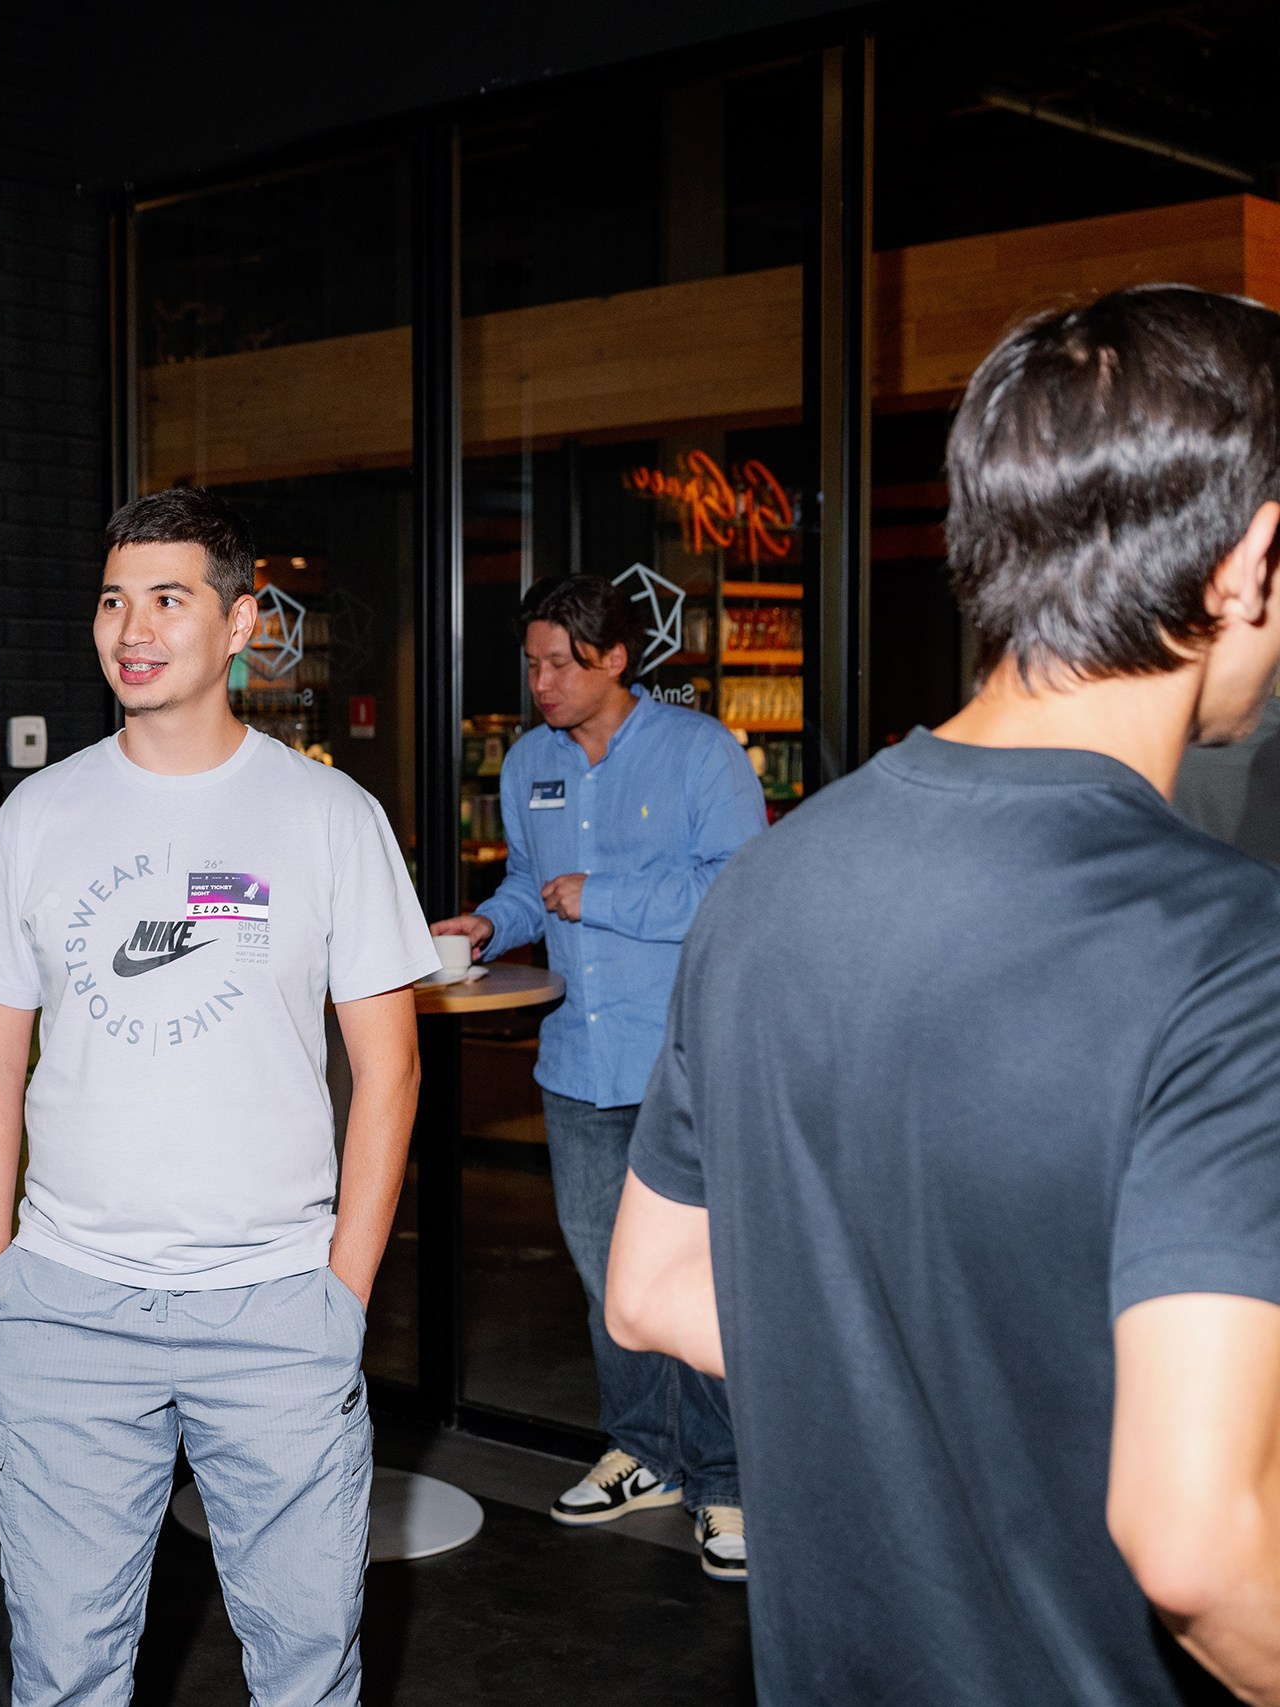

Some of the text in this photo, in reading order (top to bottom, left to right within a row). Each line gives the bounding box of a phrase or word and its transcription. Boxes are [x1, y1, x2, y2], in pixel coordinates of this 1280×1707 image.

[128, 921, 196, 952] NIKE
[237, 921, 271, 933] SINCE
[237, 932, 270, 945] 1972
[65, 854, 245, 1046] NIKE SPORTSWEAR
